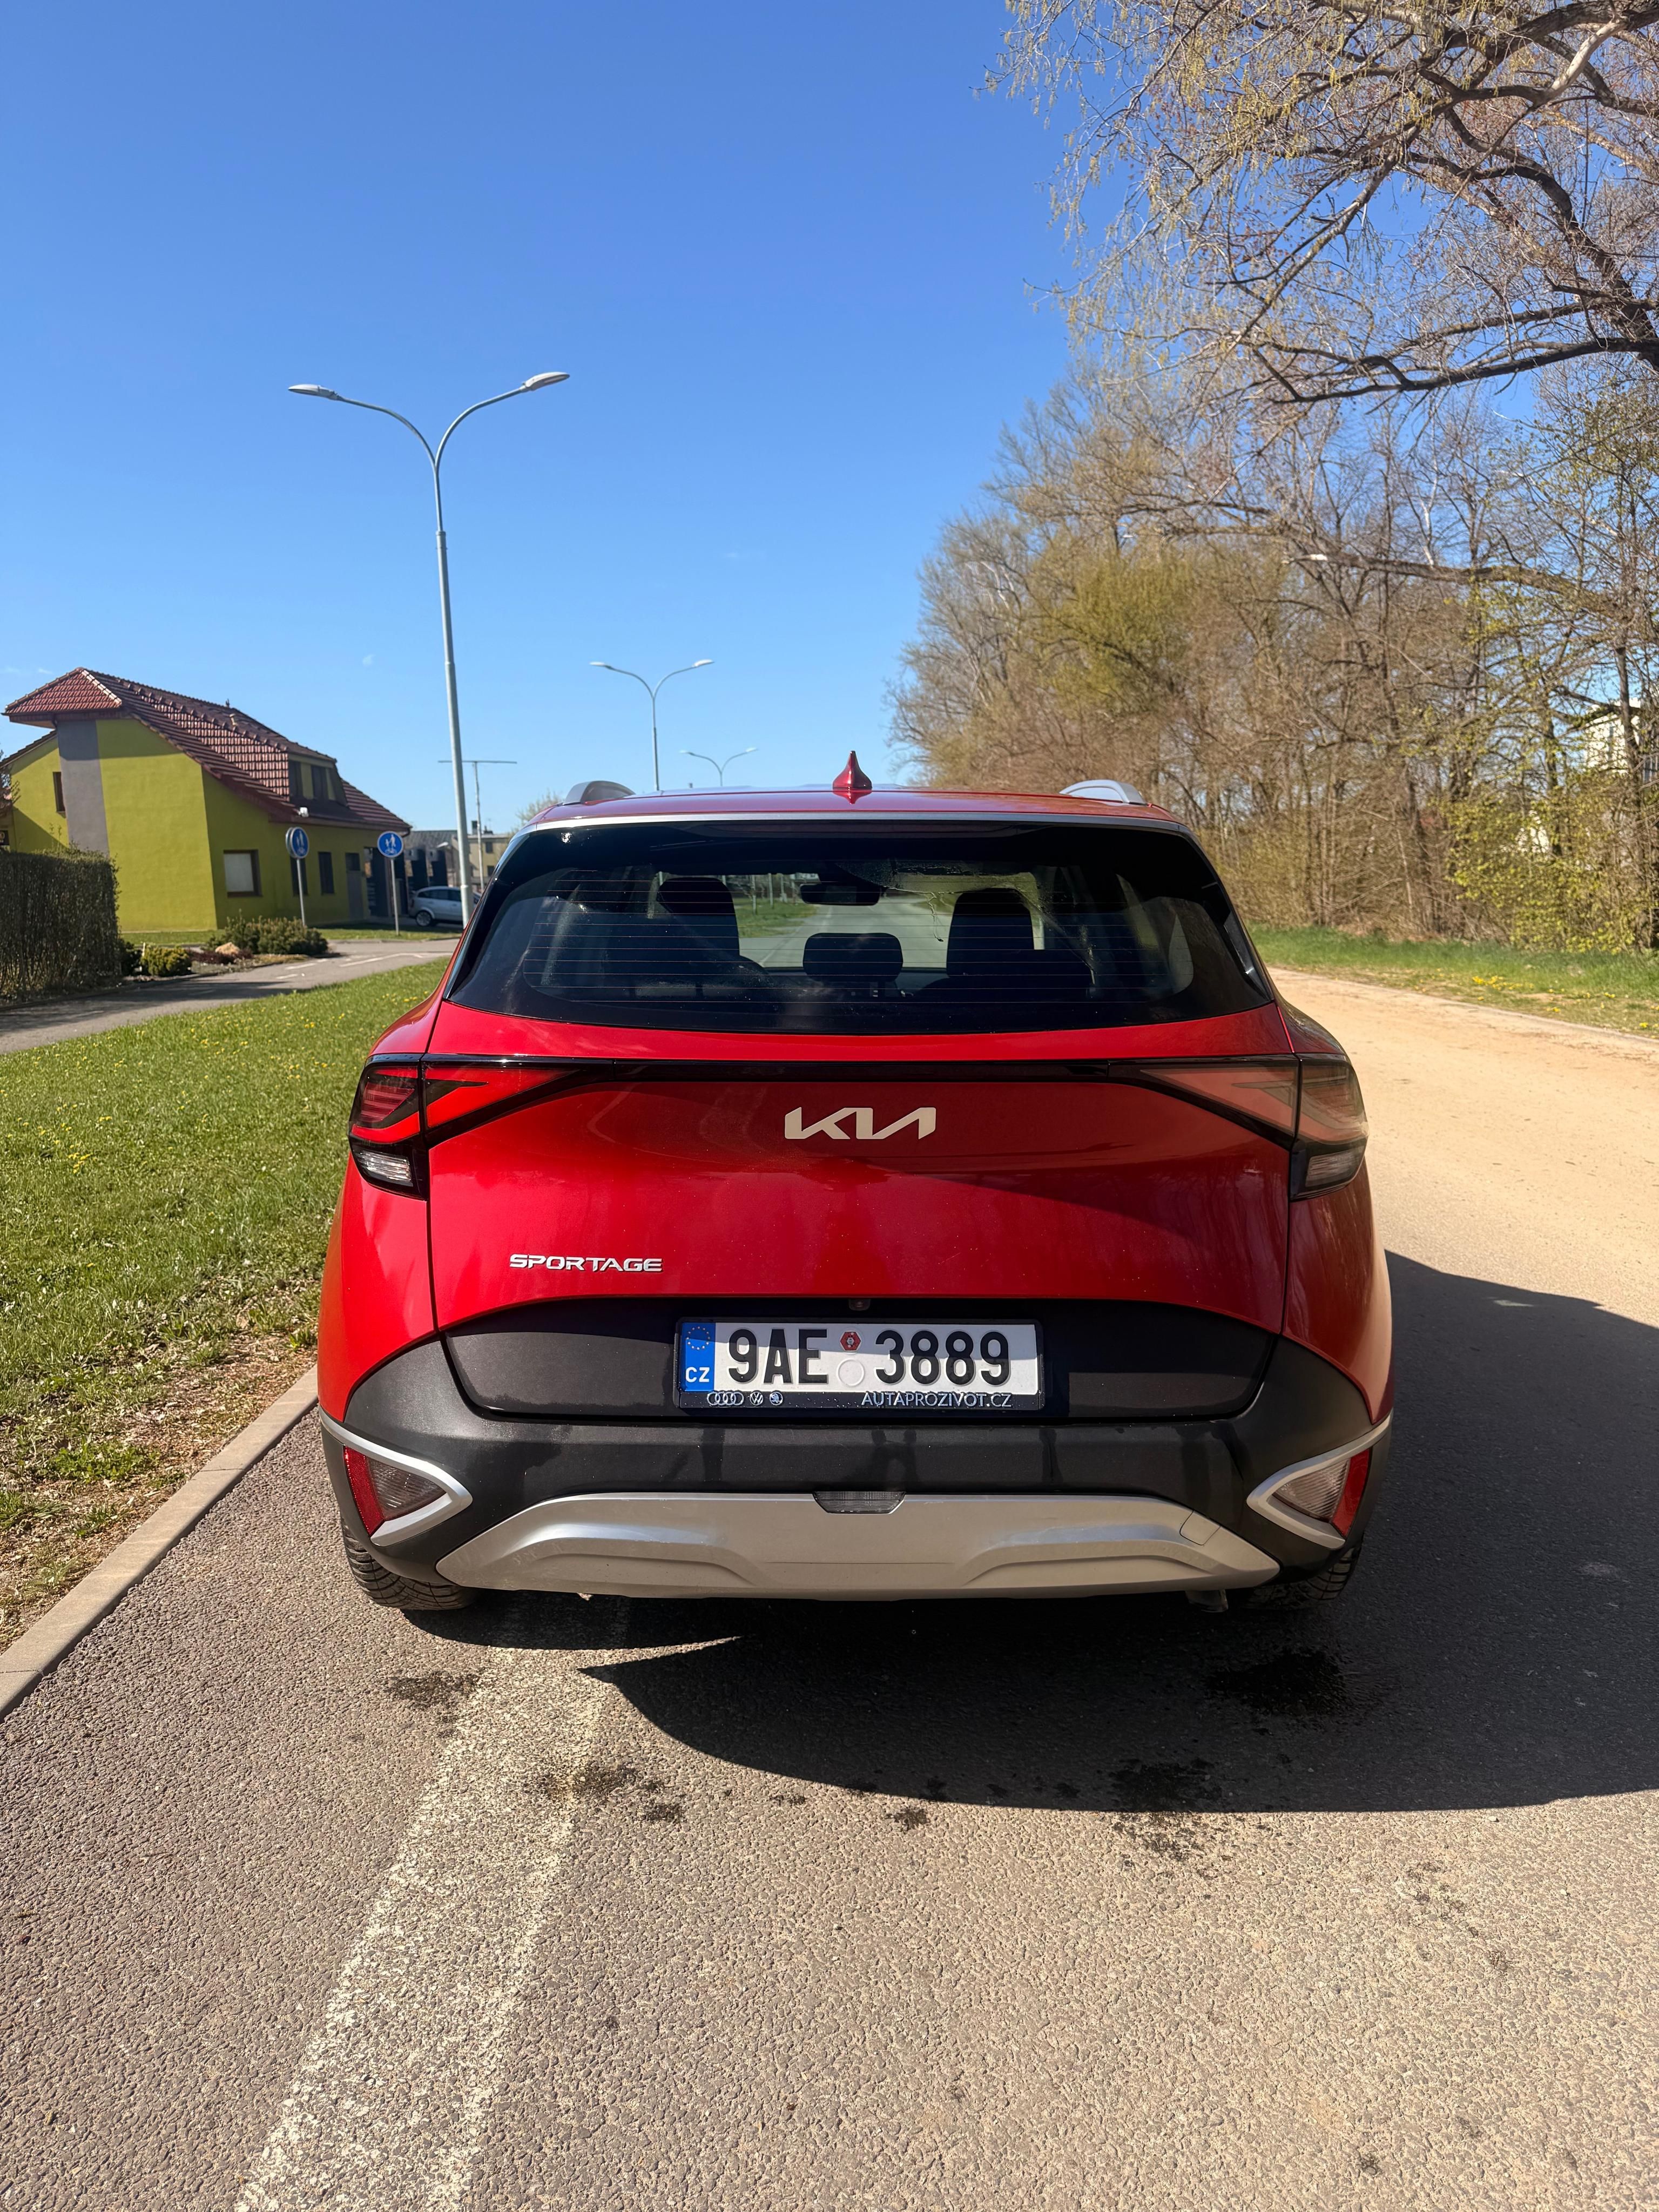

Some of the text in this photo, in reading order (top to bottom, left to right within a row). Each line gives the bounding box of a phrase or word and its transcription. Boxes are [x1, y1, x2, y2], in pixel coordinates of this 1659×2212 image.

[785, 1107, 936, 1139] KIA
[509, 1254, 663, 1272] SPORTAGE
[727, 1328, 1011, 1385] 9AE 3889
[685, 1367, 710, 1382] CZ
[861, 1392, 1012, 1407] AUTAPROZIVOT.CZ
